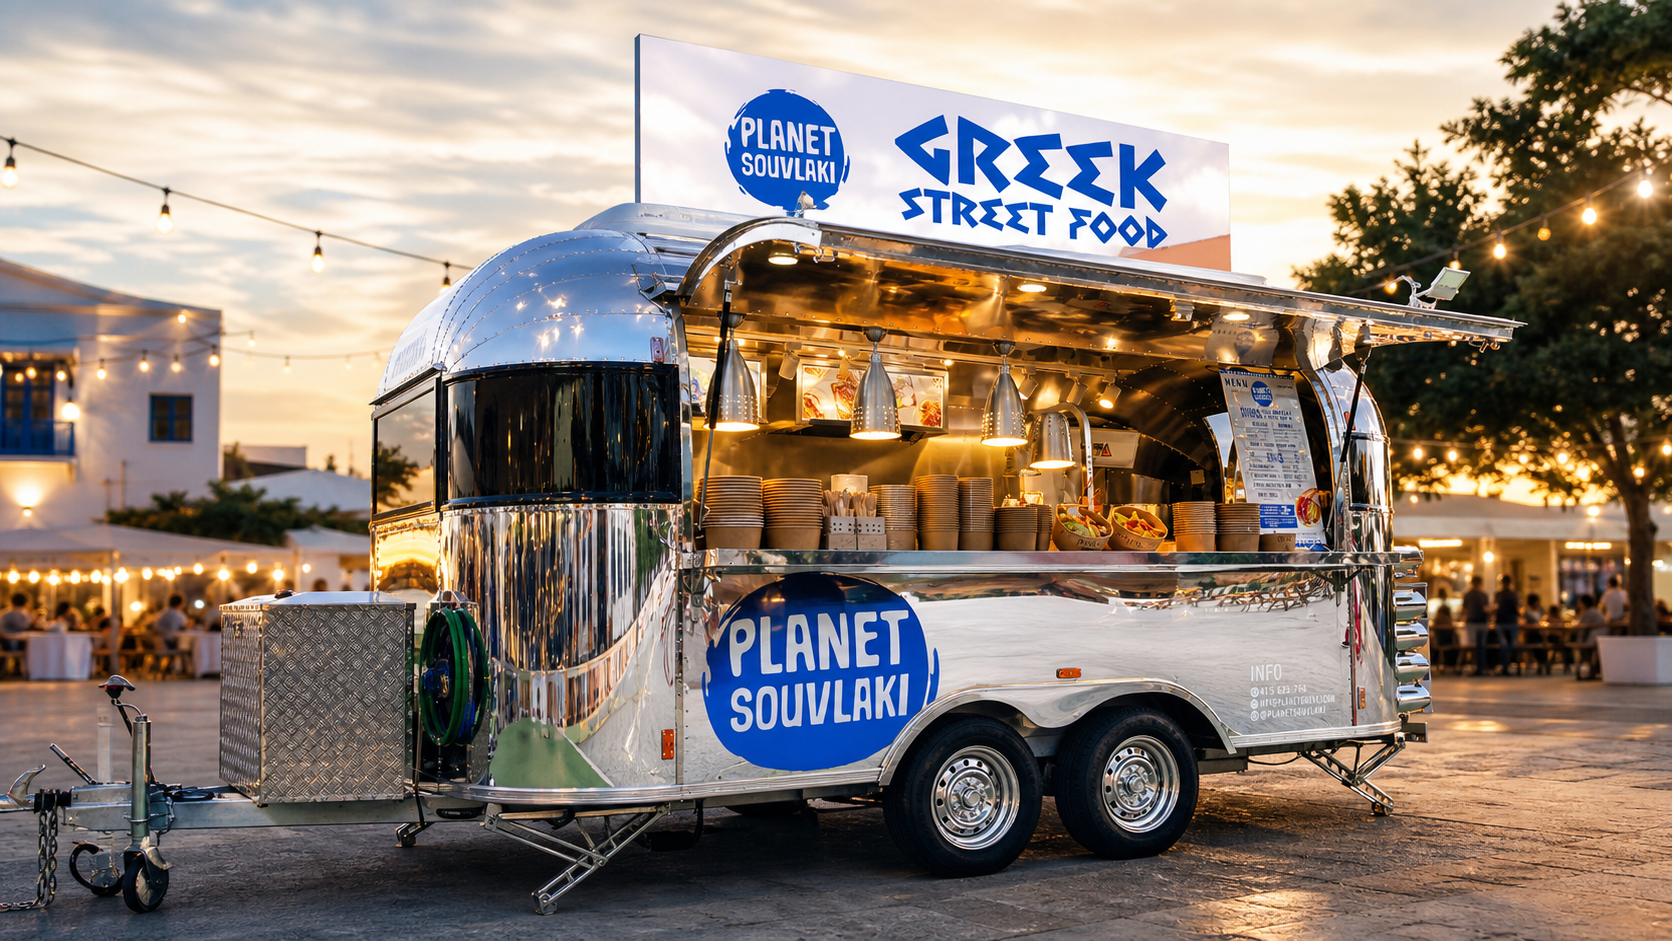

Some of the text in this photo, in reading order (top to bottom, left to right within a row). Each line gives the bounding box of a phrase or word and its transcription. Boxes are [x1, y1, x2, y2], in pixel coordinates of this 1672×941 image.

[740, 116, 836, 156] PLANET
[894, 114, 1168, 213] GREEK
[741, 152, 836, 184] SOUVLAKI
[898, 187, 1168, 249] STREET FOOD
[729, 610, 909, 677] PLANET
[1250, 663, 1282, 681] INFO
[730, 673, 909, 732] SOUVLAKI
